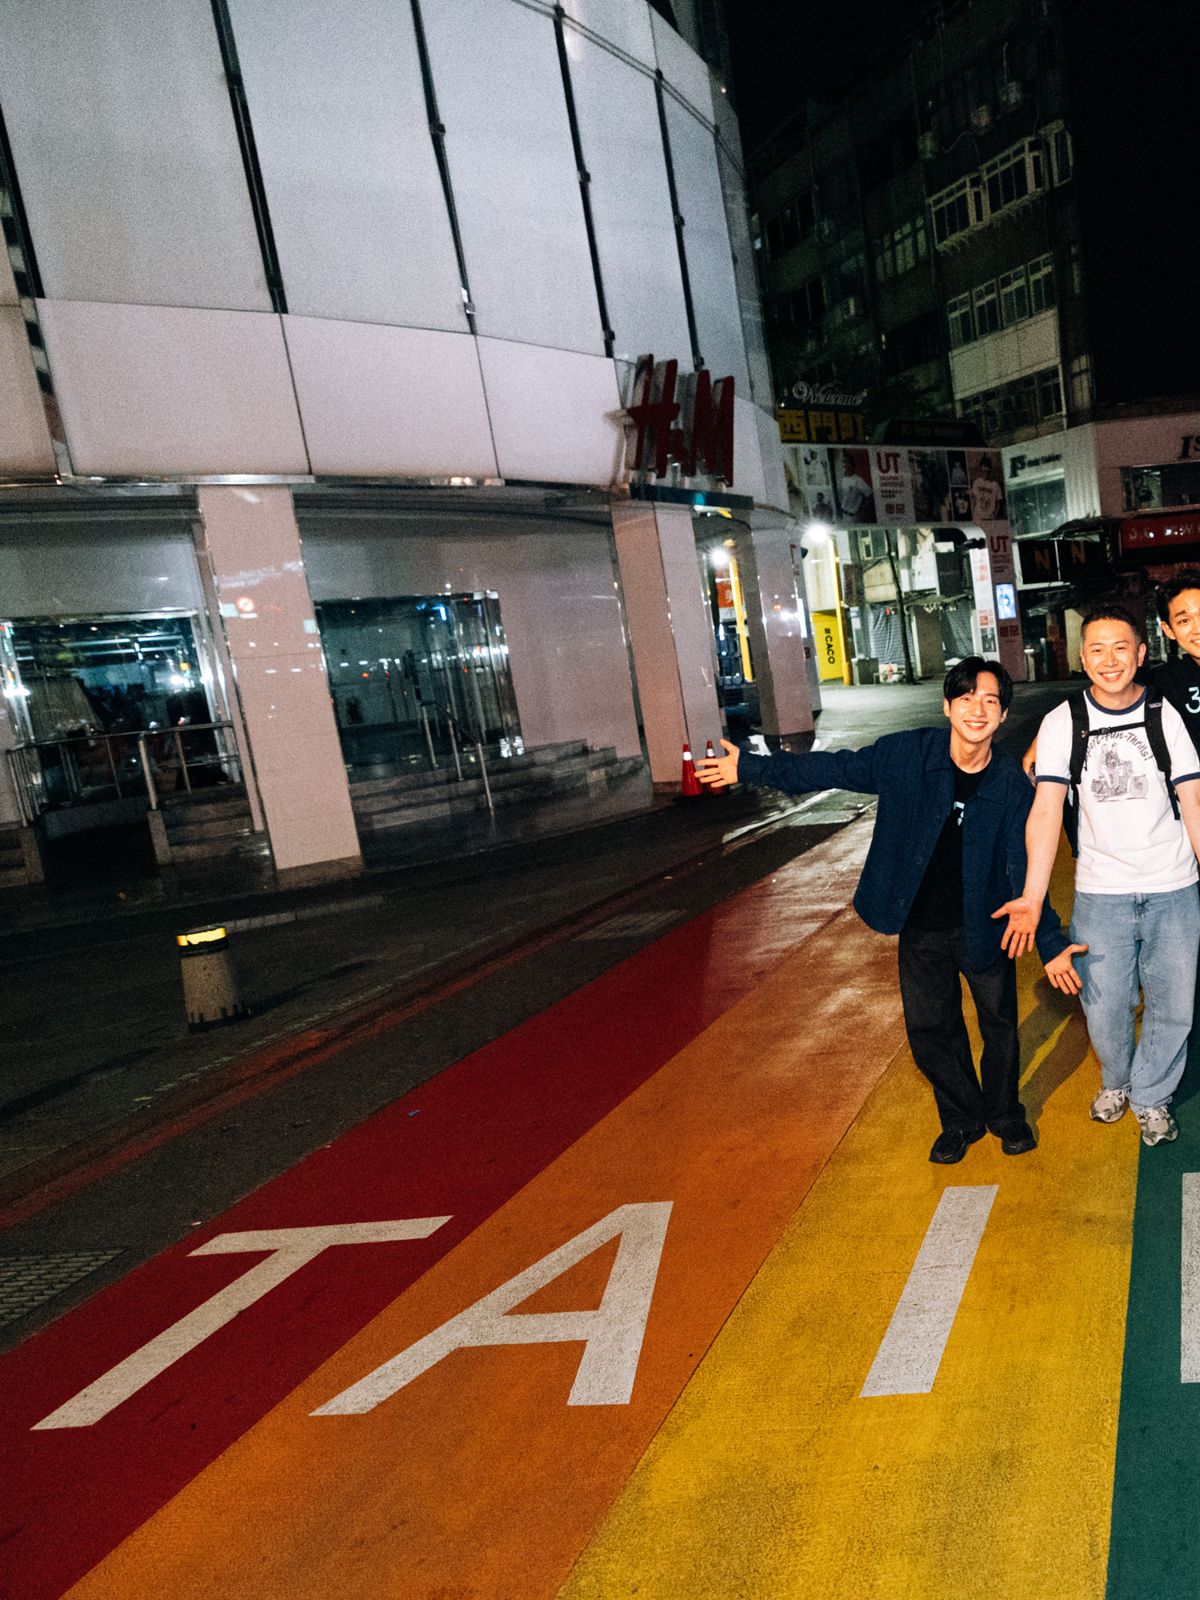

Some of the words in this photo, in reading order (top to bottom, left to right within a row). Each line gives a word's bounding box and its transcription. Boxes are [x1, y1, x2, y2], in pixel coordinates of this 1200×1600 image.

[876, 451, 900, 474] UT
[990, 536, 1009, 553] UT
[824, 627, 836, 665] #CACO
